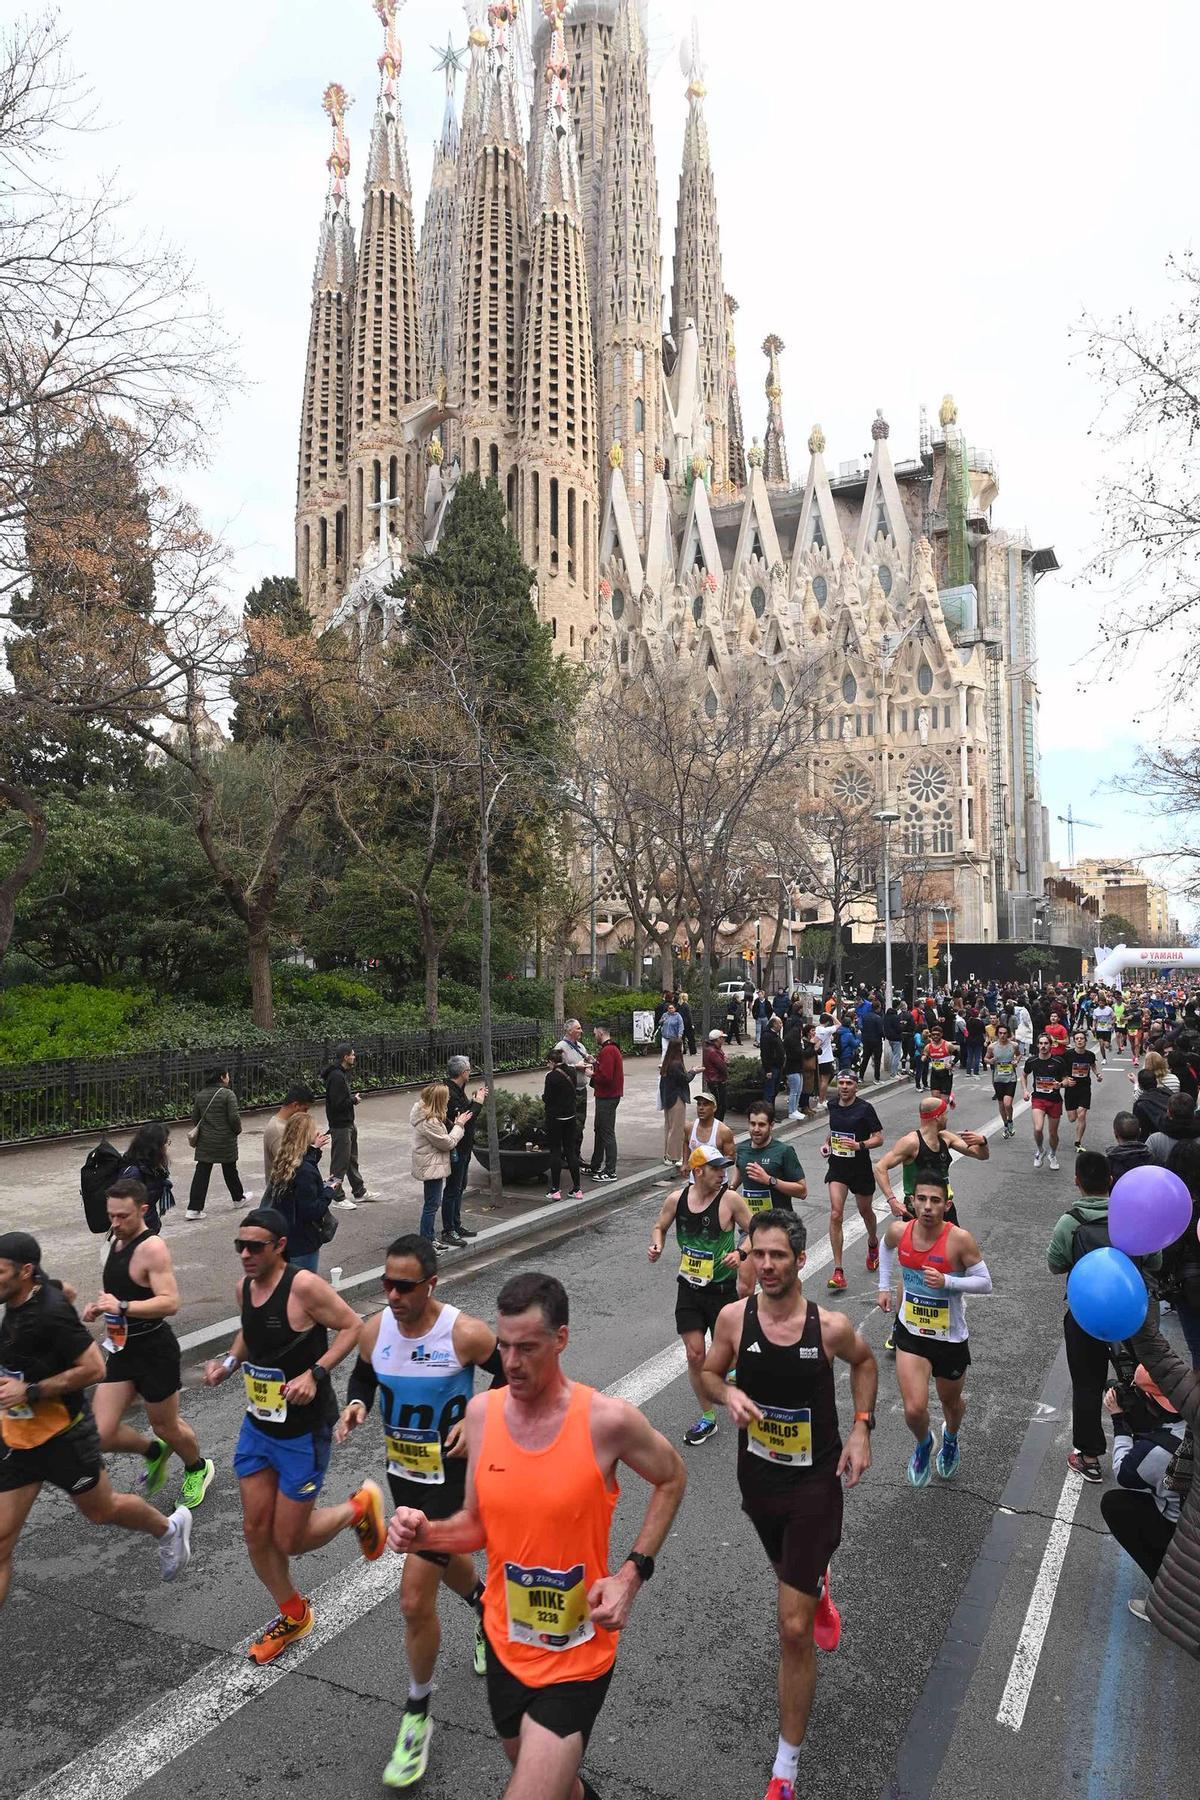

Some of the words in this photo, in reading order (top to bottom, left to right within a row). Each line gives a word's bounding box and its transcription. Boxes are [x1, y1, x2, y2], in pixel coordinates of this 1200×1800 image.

[1150, 952, 1184, 960] YAMAHA
[912, 1306, 939, 1318] EMILIO
[757, 1420, 799, 1438] CARLOS
[392, 1440, 430, 1458] MANUEL
[528, 1590, 566, 1611] MIKE
[537, 1610, 560, 1624] 3238
